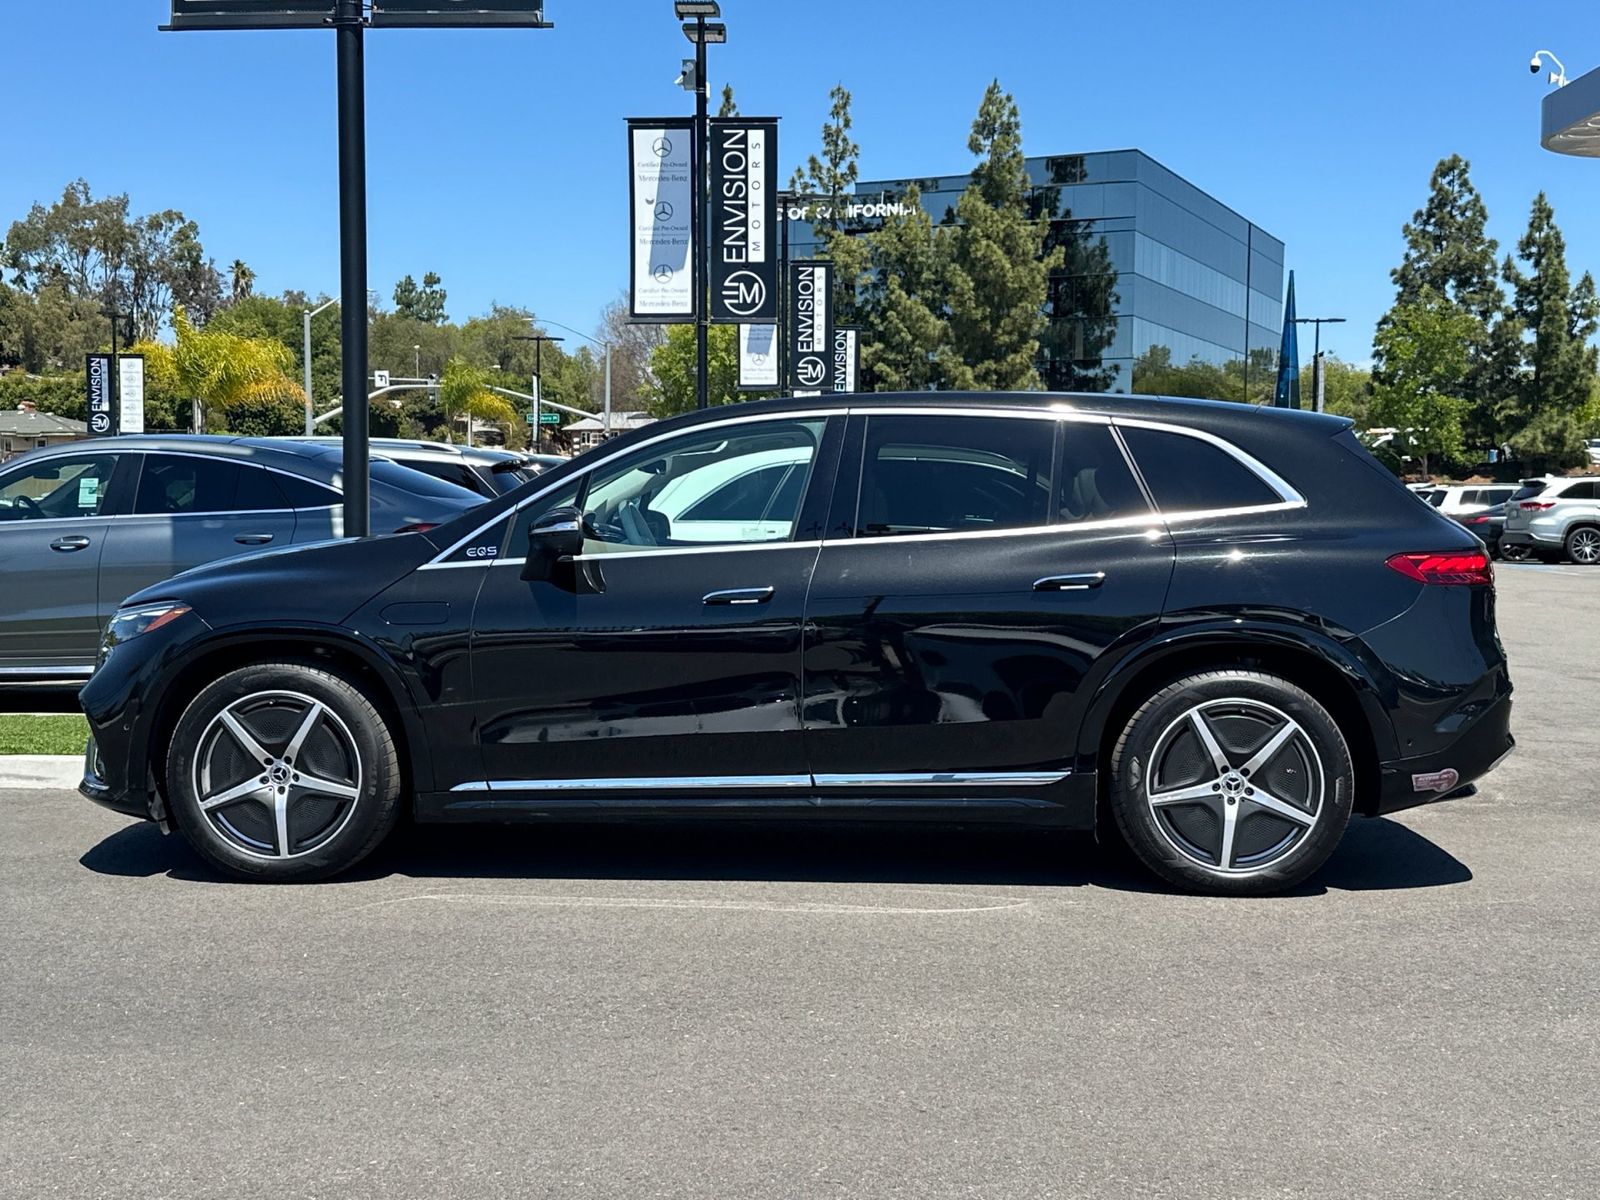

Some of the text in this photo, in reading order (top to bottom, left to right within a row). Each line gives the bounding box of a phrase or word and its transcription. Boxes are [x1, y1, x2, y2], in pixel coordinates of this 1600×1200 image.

[723, 129, 746, 263] ENVISION
[751, 142, 761, 252] MOTORS
[816, 202, 917, 219] CAIFORNIA
[797, 266, 814, 352] ENVISION
[90, 357, 102, 412] ENVISION
[834, 329, 847, 392] ENVISION
[466, 546, 498, 557] EQS
